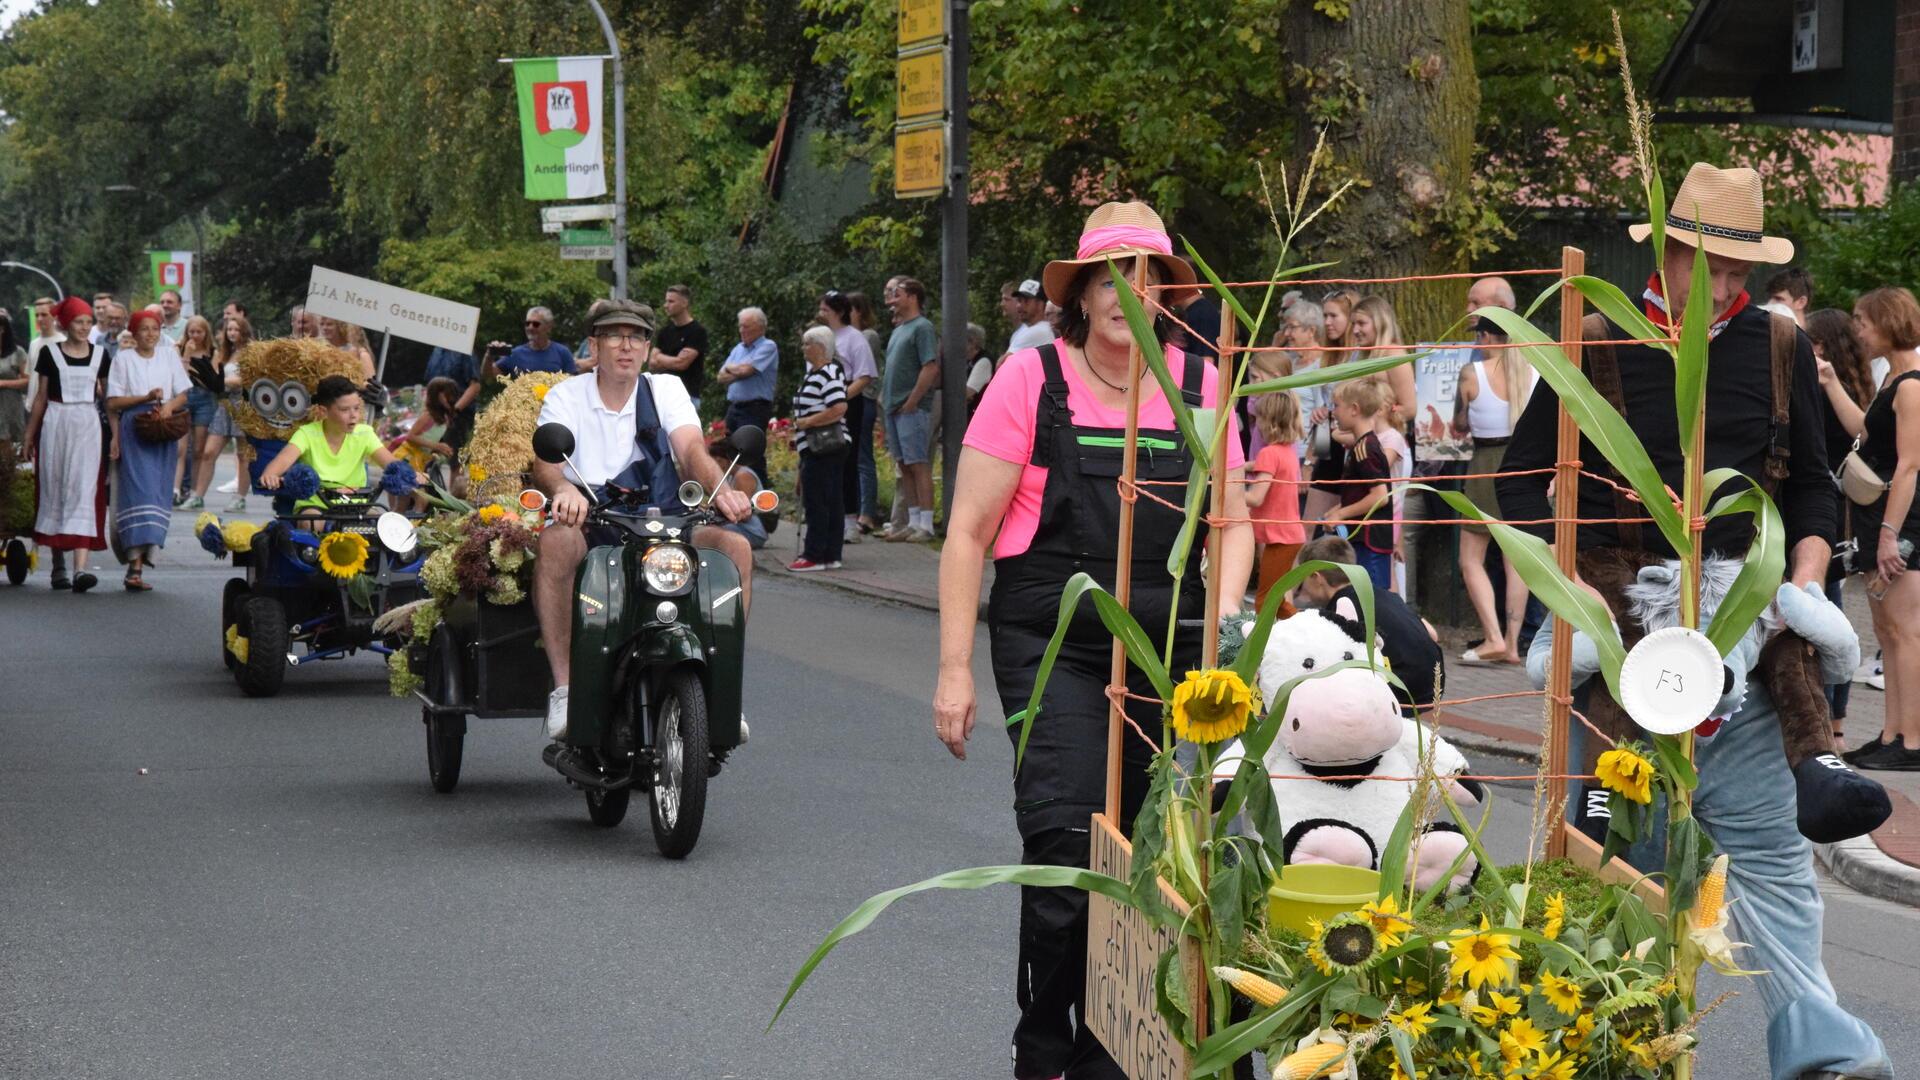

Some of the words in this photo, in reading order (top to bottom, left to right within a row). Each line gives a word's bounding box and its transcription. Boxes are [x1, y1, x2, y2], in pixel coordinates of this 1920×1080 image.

[344, 290, 379, 311] Next
[389, 303, 469, 335] Generation
[1655, 669, 1684, 693] F3
